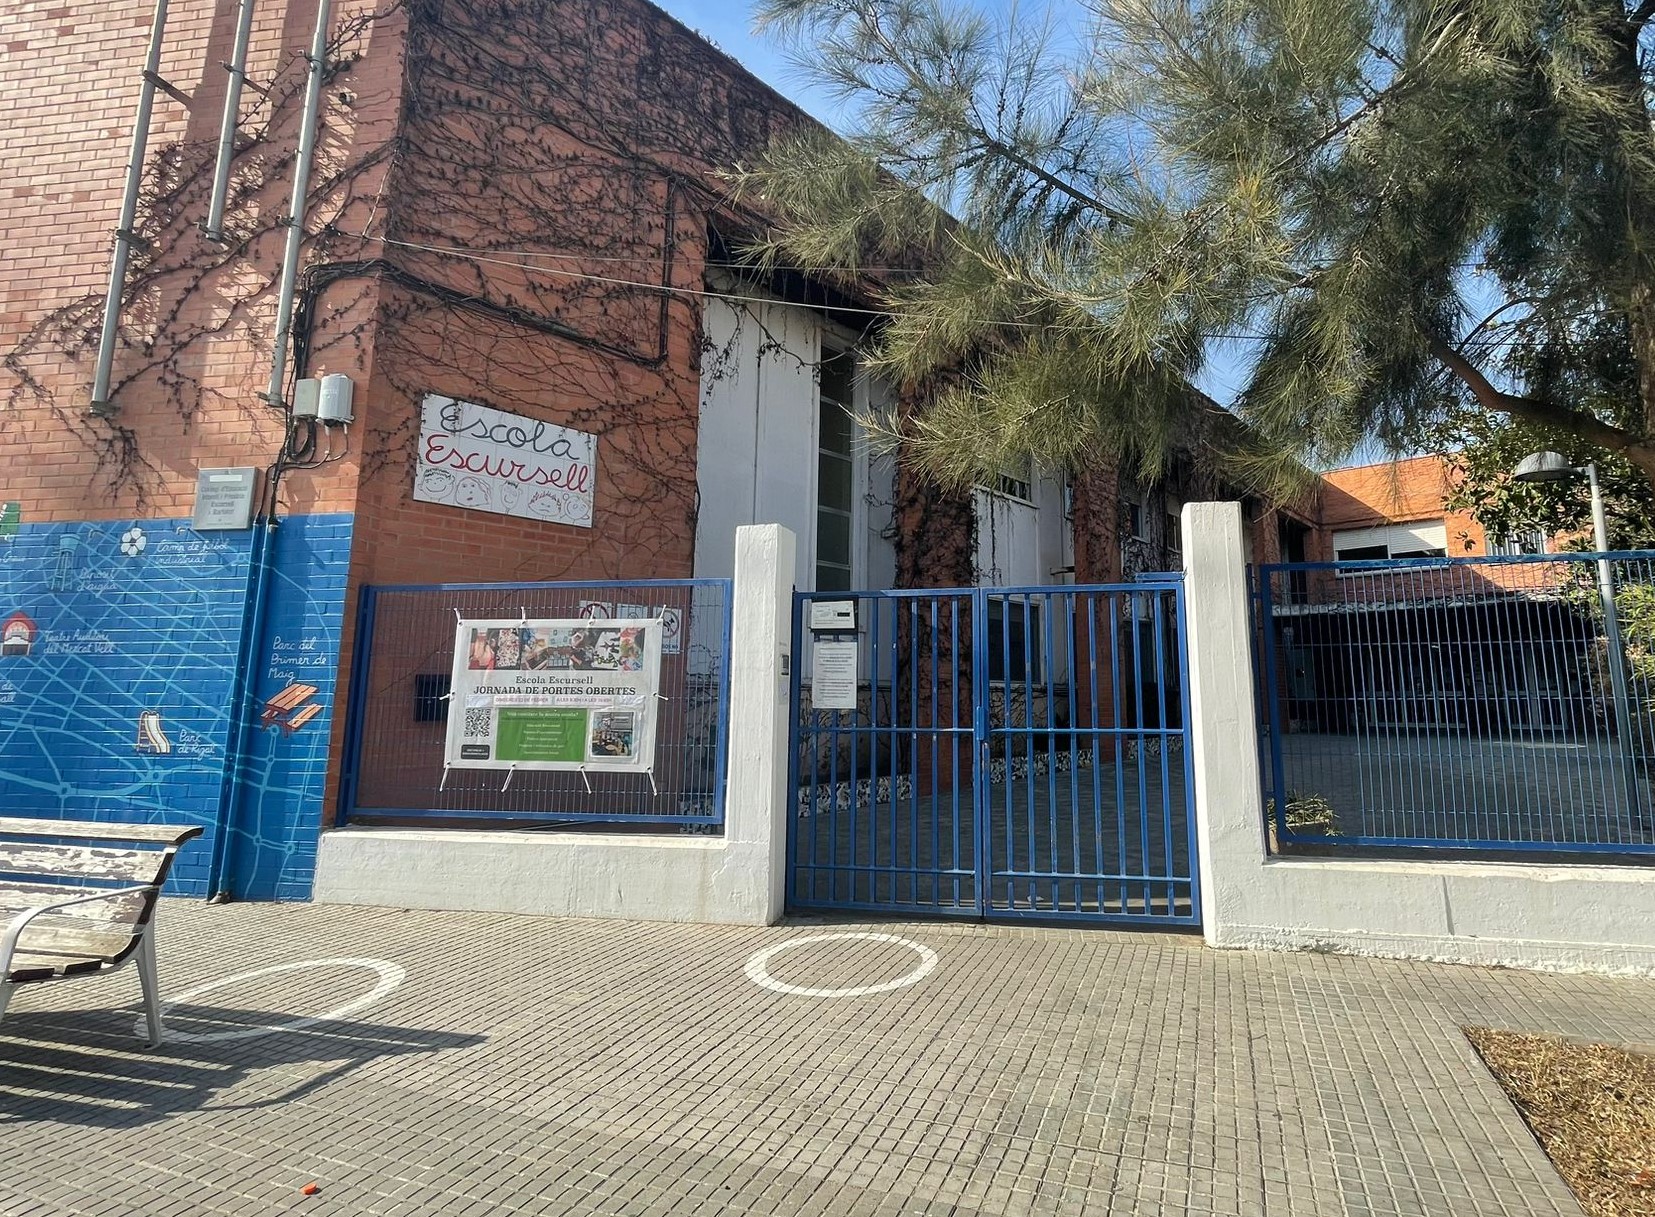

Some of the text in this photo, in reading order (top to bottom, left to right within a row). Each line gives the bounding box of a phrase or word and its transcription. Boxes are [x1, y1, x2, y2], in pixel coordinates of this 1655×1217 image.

[440, 403, 580, 460] Escola
[425, 434, 589, 493] Escursell
[187, 540, 200, 551] de
[45, 630, 71, 642] Teatre
[43, 643, 59, 654] del
[94, 642, 114, 653] Vell
[273, 636, 317, 650] Parc del
[270, 652, 327, 665] Primer de
[268, 667, 295, 687] Maig
[516, 675, 594, 685] Escola Escursell
[473, 686, 637, 696] JORNADA DE PORTES OBERTES
[179, 729, 201, 742] Parc
[178, 742, 189, 754] de
